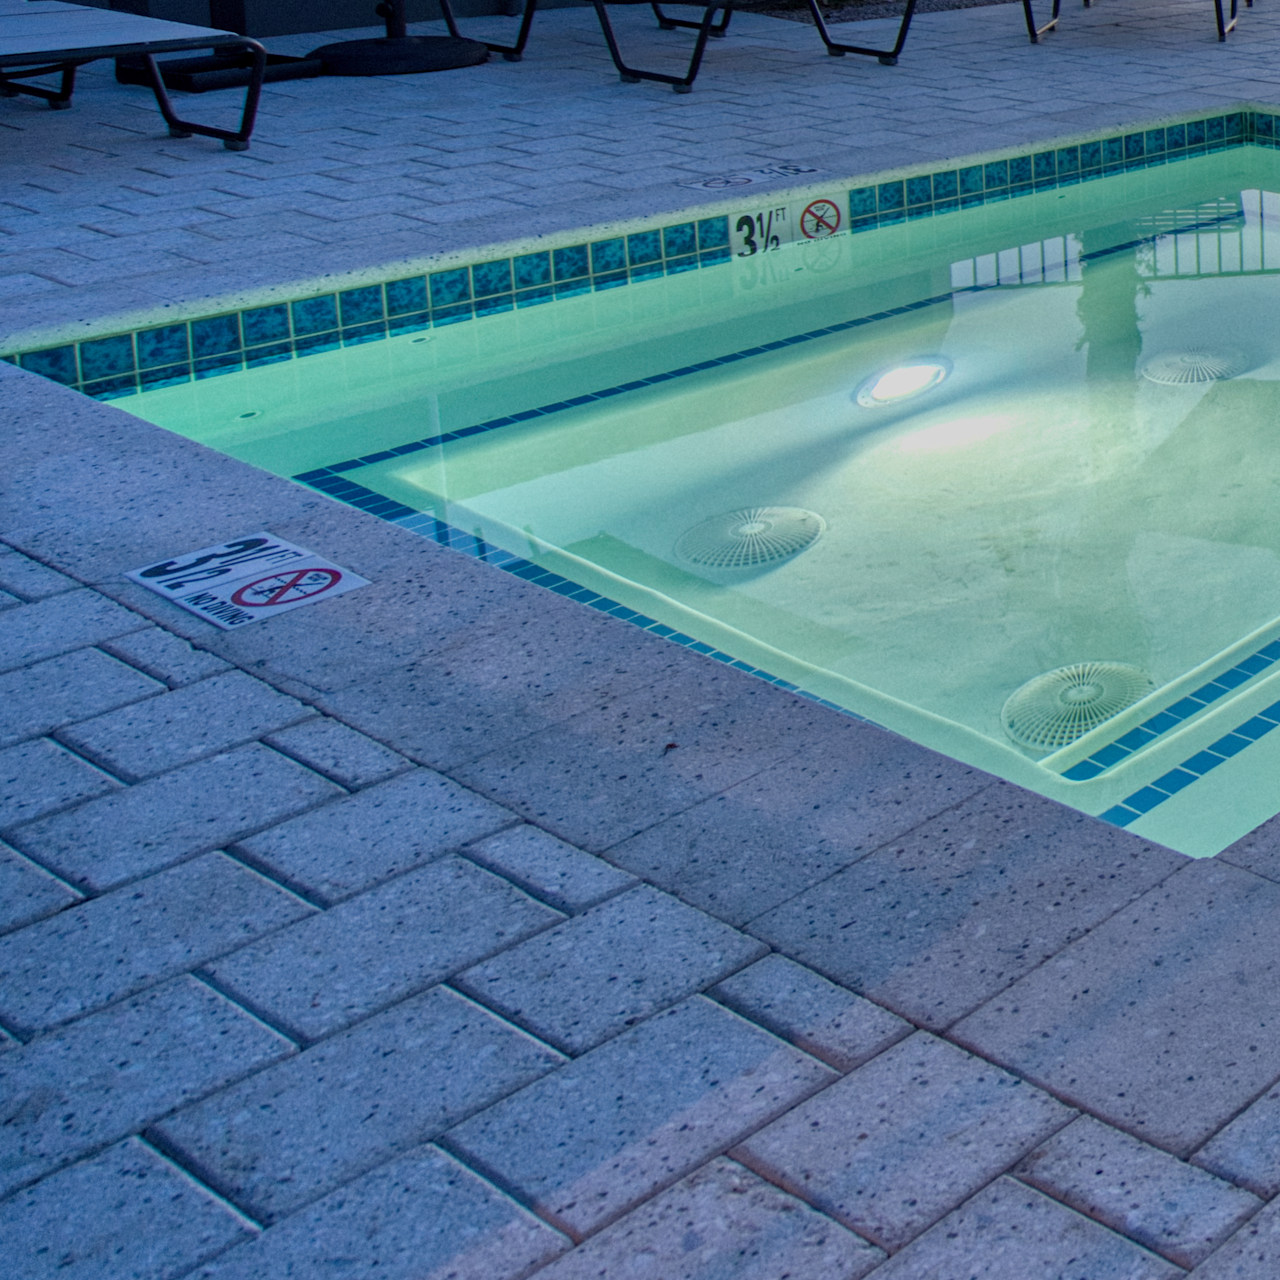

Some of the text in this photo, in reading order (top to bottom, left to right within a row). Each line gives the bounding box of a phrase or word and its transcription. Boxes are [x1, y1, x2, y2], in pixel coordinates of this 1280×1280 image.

[775, 207, 786, 222] FT
[185, 592, 254, 625] NO DIVING
